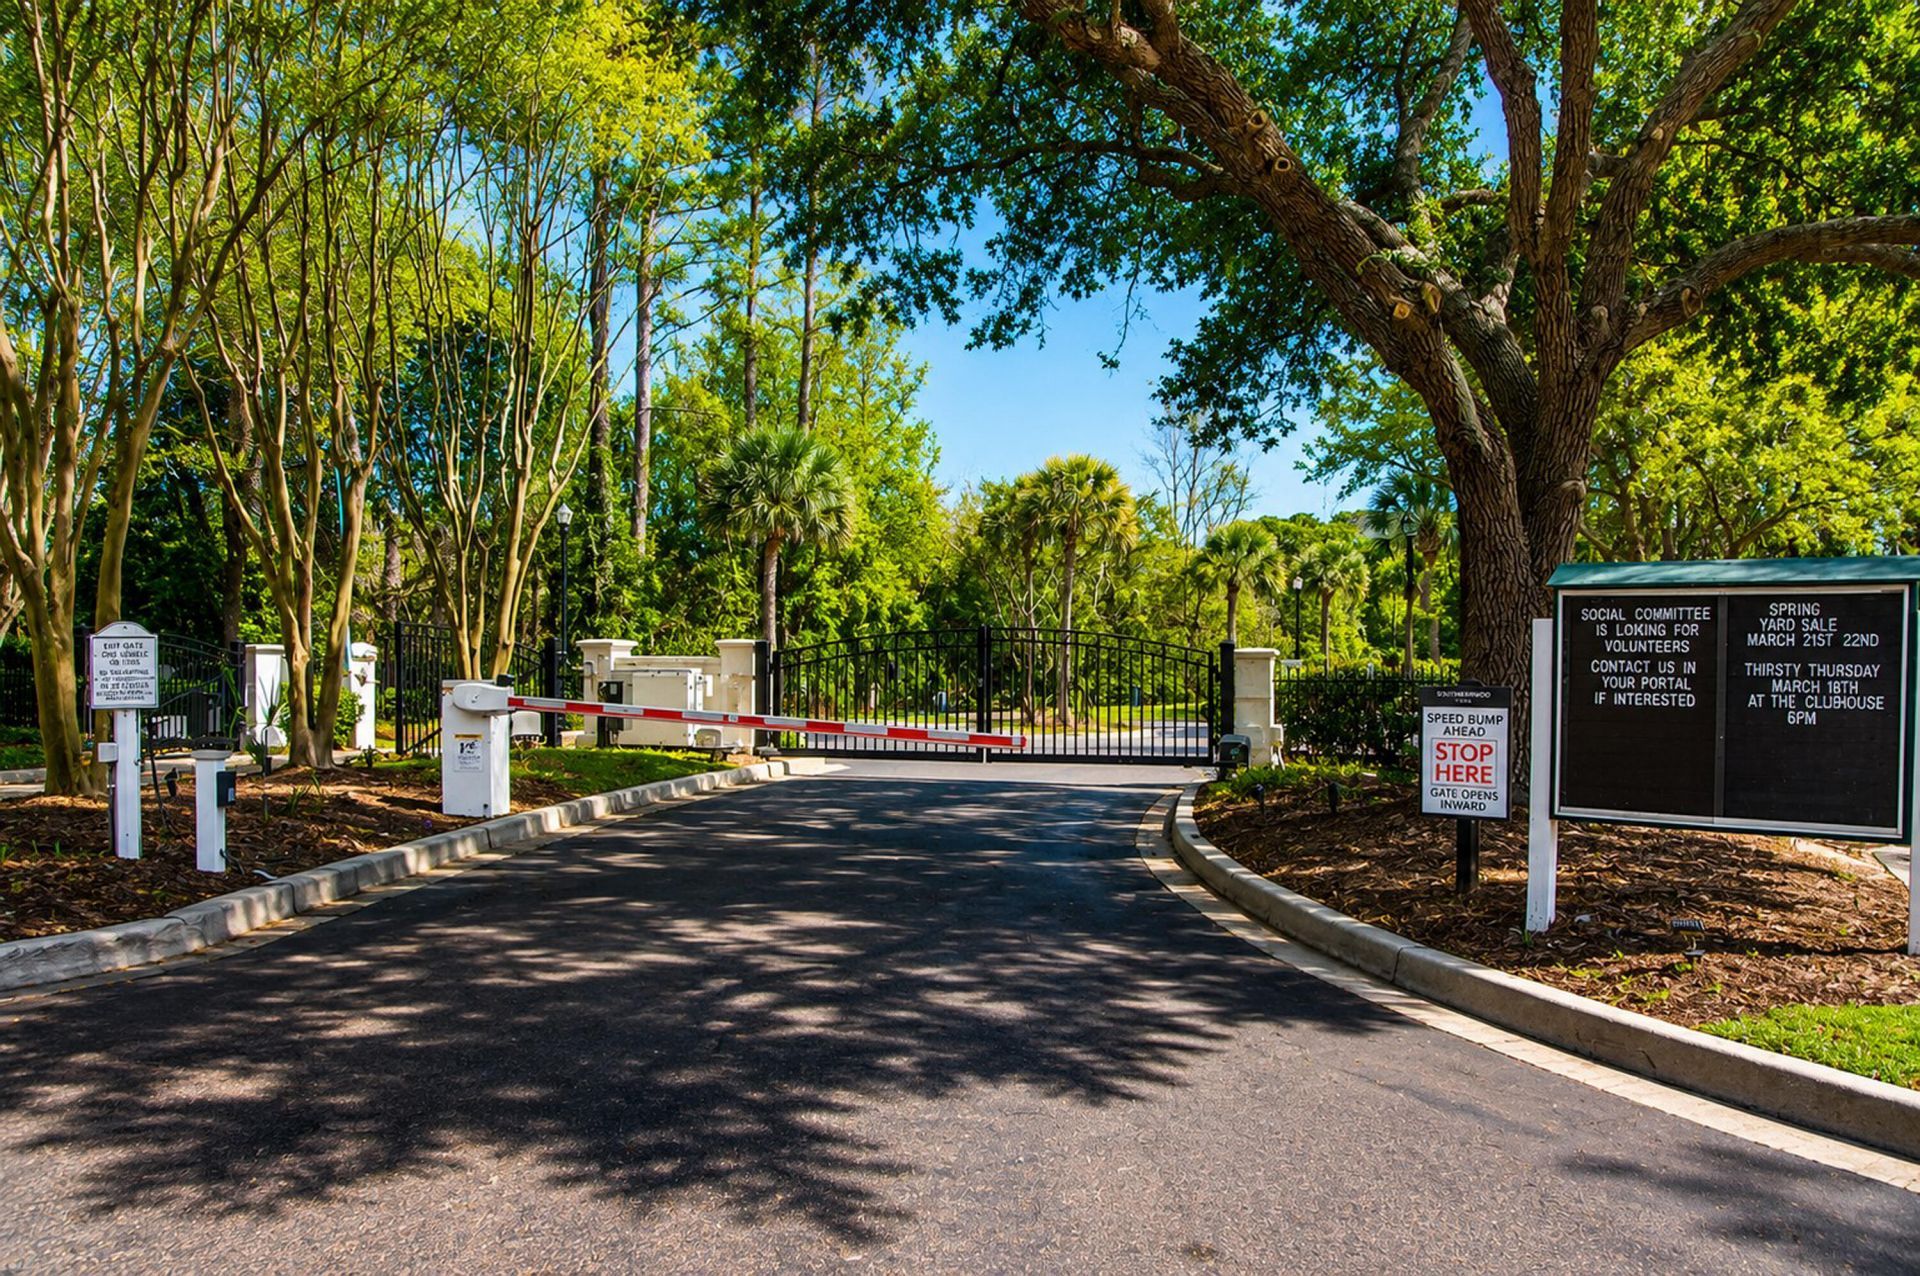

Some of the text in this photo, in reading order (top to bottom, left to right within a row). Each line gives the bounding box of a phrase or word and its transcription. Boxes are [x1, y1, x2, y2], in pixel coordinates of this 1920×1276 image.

[1581, 607, 1711, 621] SOCIAL COMMITTEE
[1769, 603, 1820, 616] SPRING
[1596, 623, 1699, 636] IS LOKING FOR
[1759, 618, 1837, 631] YARD SALE
[1604, 640, 1690, 653] VOLUNTEERS
[1747, 633, 1879, 647] MARCH 21ST 22ND
[1591, 660, 1696, 673] CONTACT US IN
[1744, 663, 1880, 677] THIRSTY THURSDAY
[1602, 676, 1692, 690] YOUR PORTAL
[1771, 680, 1859, 694] MARCH 18TH
[1595, 692, 1696, 706] IF INTERESTED
[1747, 695, 1885, 709] AT THE CLUBHOUSE
[1427, 713, 1504, 725] SPEED BUMP
[1787, 711, 1817, 725] 6PM
[1443, 726, 1486, 736] AHEAD
[1436, 742, 1493, 762] STOP
[1436, 763, 1493, 784] HERE
[1430, 788, 1499, 801] GATE OPENS
[1440, 800, 1487, 811] INWARD
